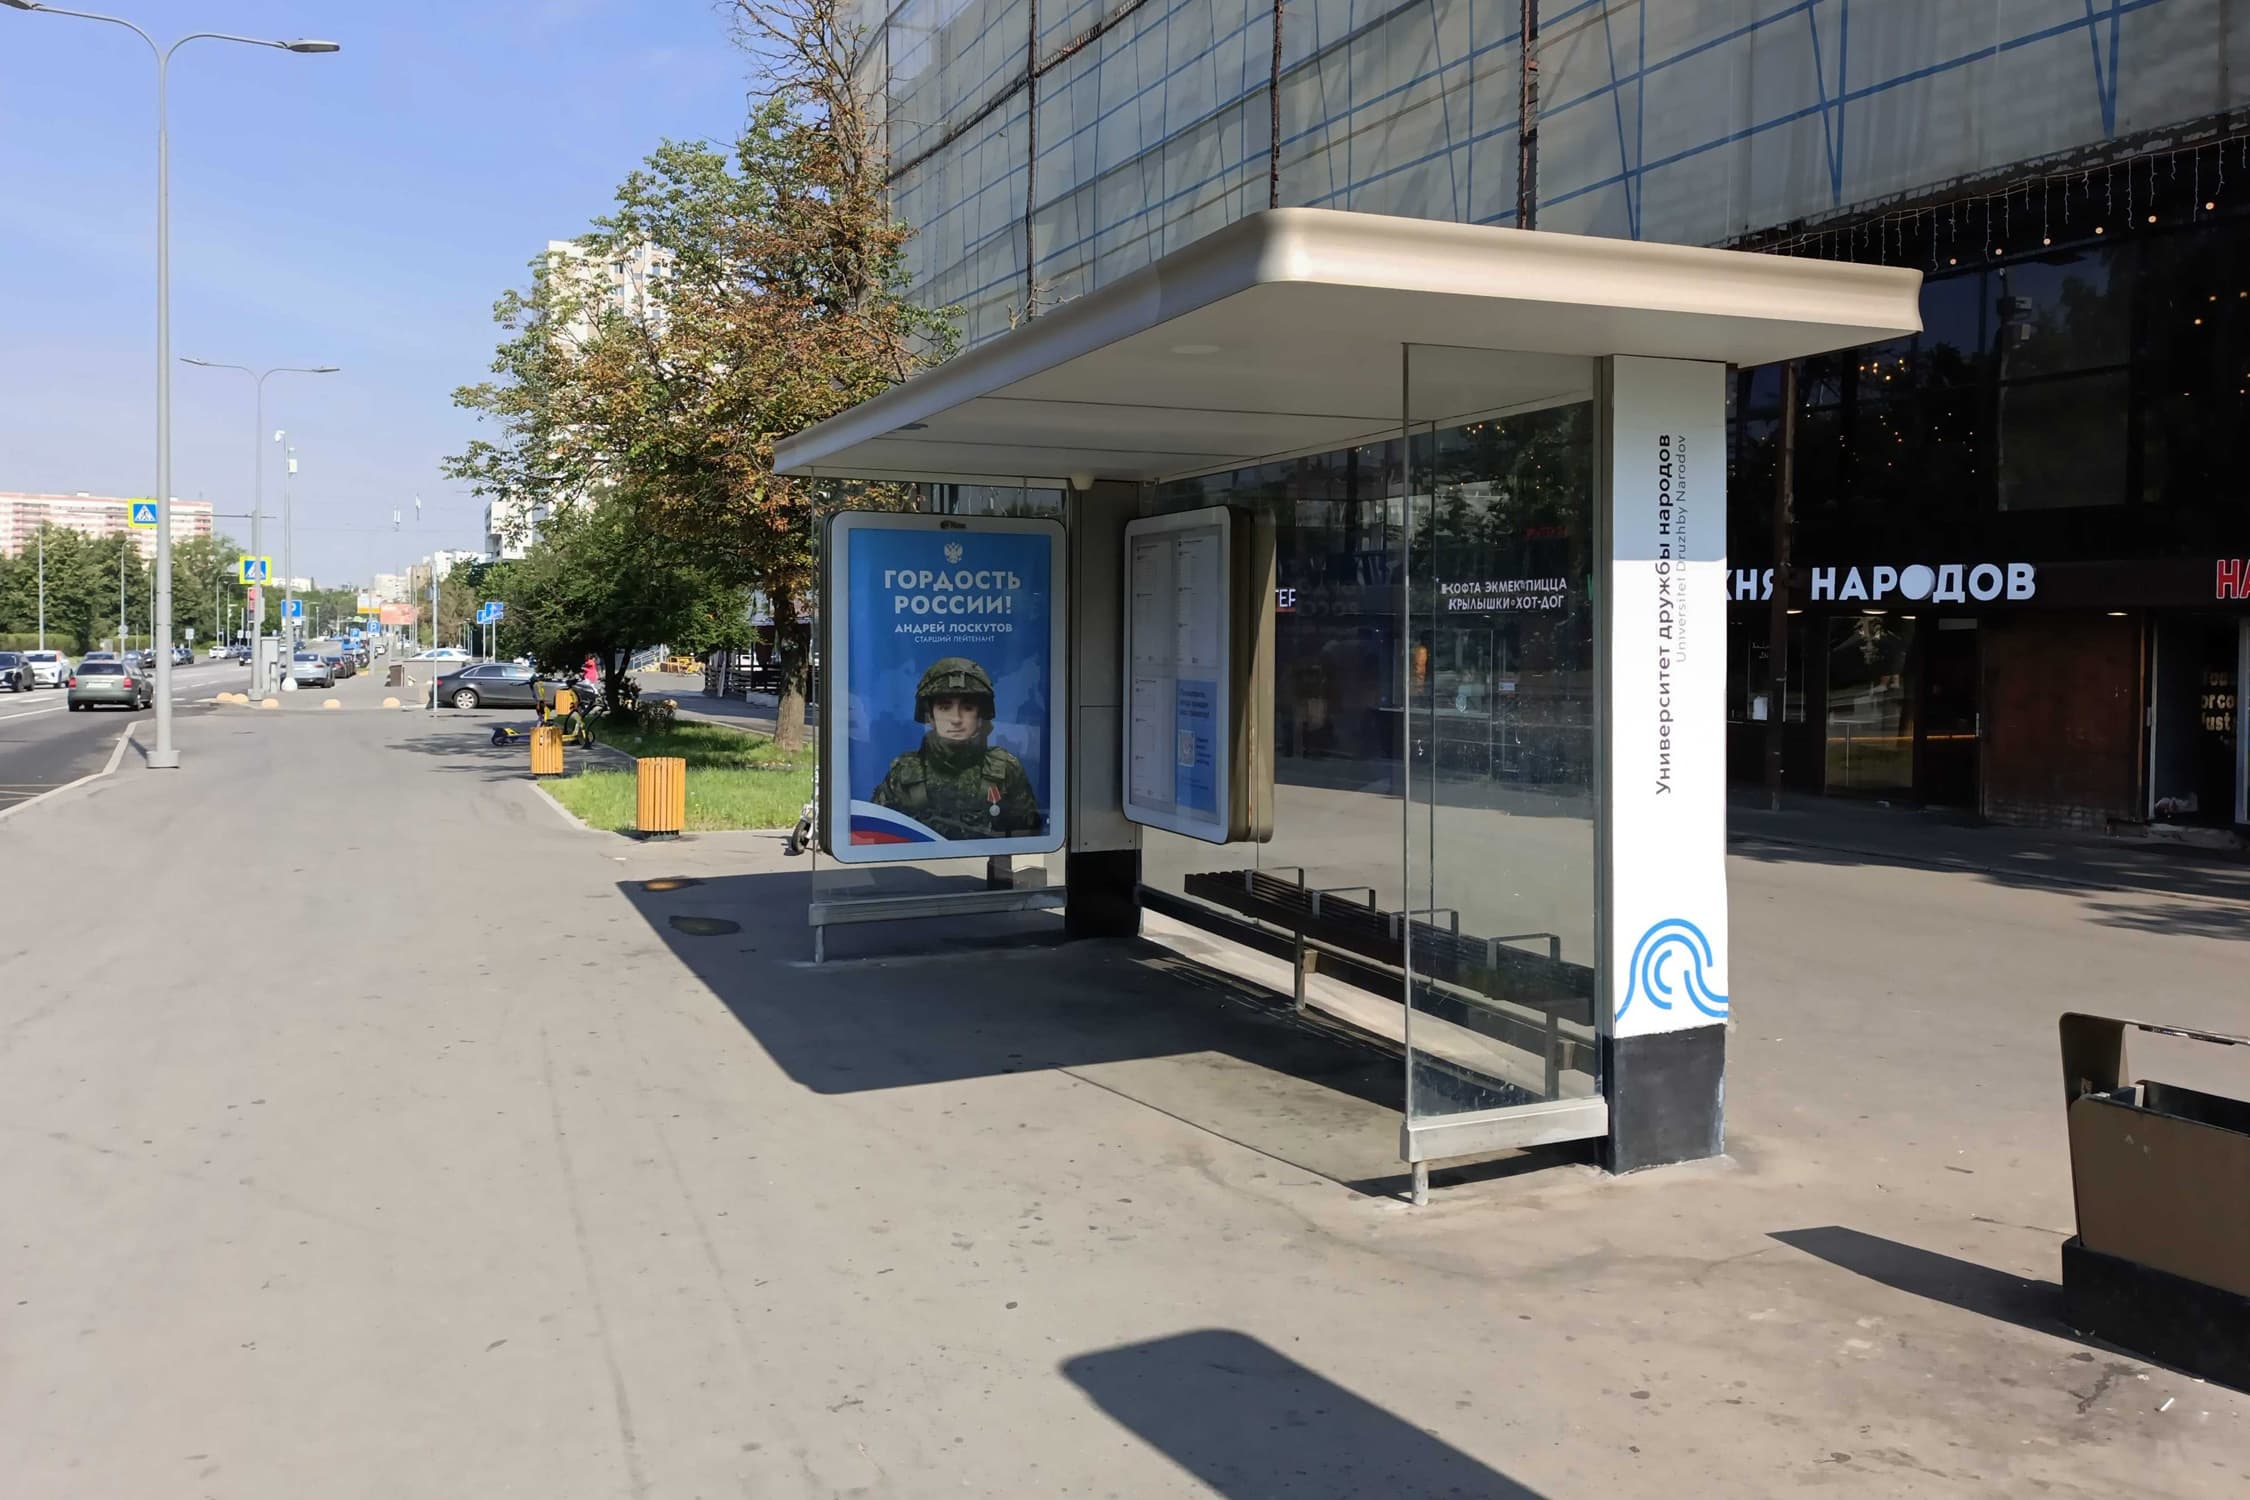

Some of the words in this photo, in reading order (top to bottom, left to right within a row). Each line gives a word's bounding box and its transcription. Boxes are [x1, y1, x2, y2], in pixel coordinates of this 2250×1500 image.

[1659, 434, 1674, 535] народов
[1675, 435, 1687, 502] Narodov
[1675, 505, 1688, 572] Druzhby
[884, 569, 1021, 592] ГОРДОСТЬ
[1484, 579, 1521, 593] ЭКМЕК
[1525, 577, 1567, 592] ПИЦЦА
[1655, 543, 1674, 640] дружбы
[1727, 568, 1774, 600] НЯ
[1811, 562, 2037, 603] НАРОДОВ
[894, 595, 1012, 615] РОССИИ!
[1448, 597, 1511, 611] КРЫЛЫШКИ
[1515, 594, 1565, 610] ХОТ-ДОГ
[894, 621, 945, 634] АНДРЕЙ
[948, 623, 1013, 633] ЛОСКУТОВ
[914, 634, 951, 643] СТАРШИЙ
[1655, 646, 1674, 795] Университет
